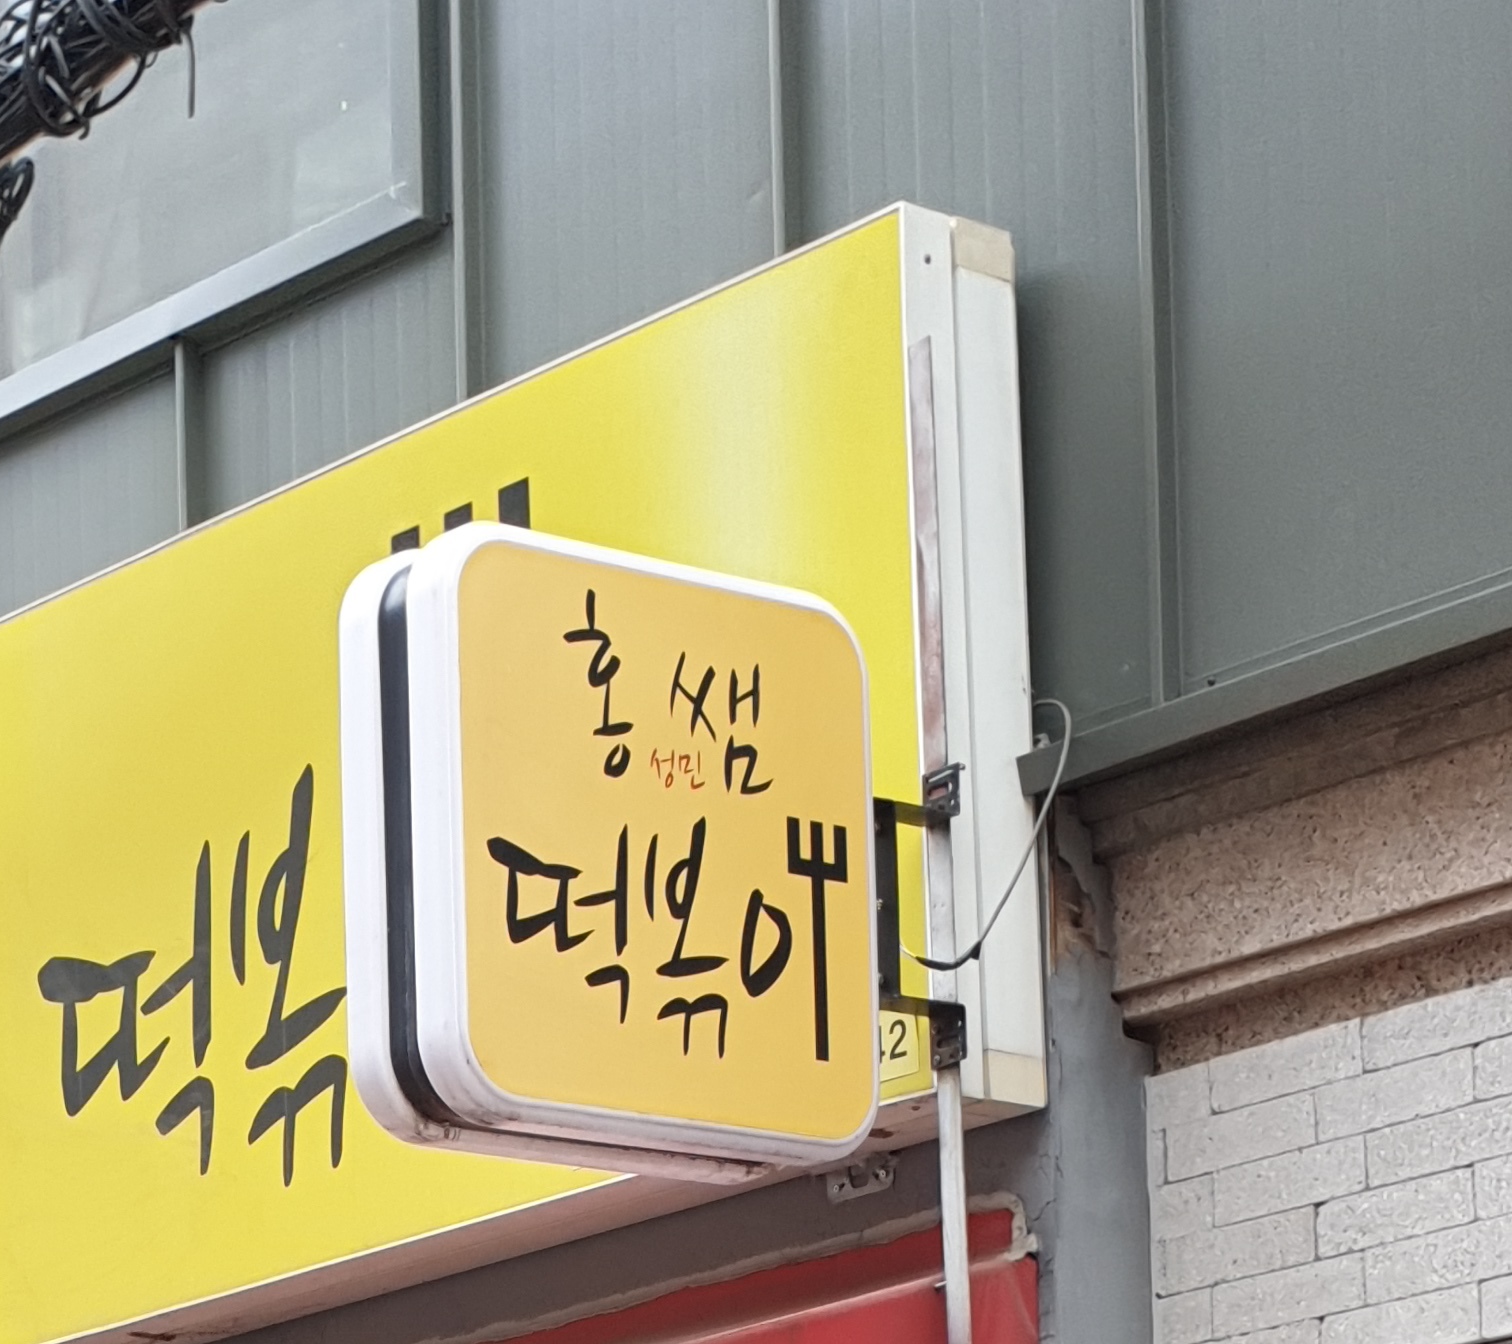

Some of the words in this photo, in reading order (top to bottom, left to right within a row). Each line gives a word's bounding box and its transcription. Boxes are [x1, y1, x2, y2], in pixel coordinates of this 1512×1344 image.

[564, 590, 633, 778] 홍
[670, 652, 772, 795] 쌤
[650, 748, 706, 790] 성민
